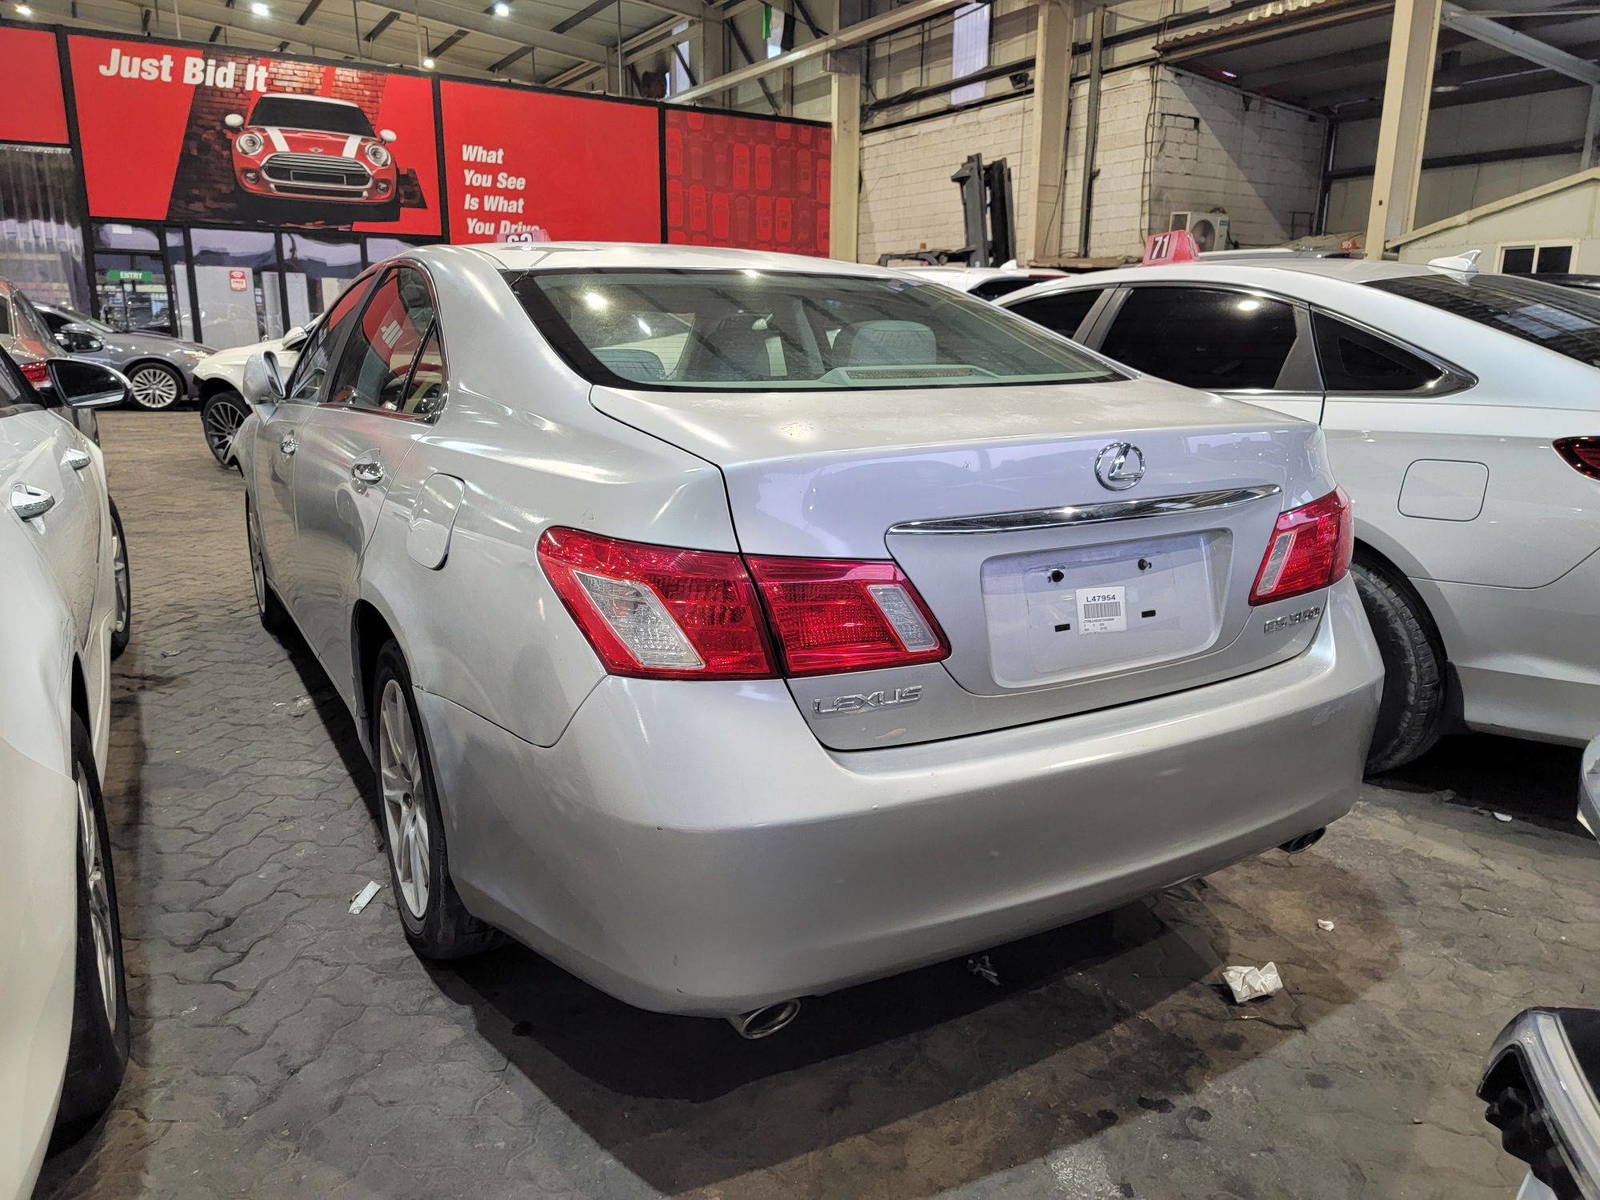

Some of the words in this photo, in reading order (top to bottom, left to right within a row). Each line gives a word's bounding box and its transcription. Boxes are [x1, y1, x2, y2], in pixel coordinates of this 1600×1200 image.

[99, 48, 174, 83] Just
[183, 56, 236, 89] Bid
[245, 63, 269, 93] It
[462, 144, 505, 165] What
[463, 169, 493, 188] You
[496, 171, 527, 190] See
[464, 193, 480, 211] Is
[483, 195, 525, 214] What
[466, 217, 496, 236] You
[1151, 233, 1172, 260] 71
[119, 271, 143, 280] ENTRY
[1086, 594, 1116, 603] L47954
[813, 684, 923, 714] LEXUS
